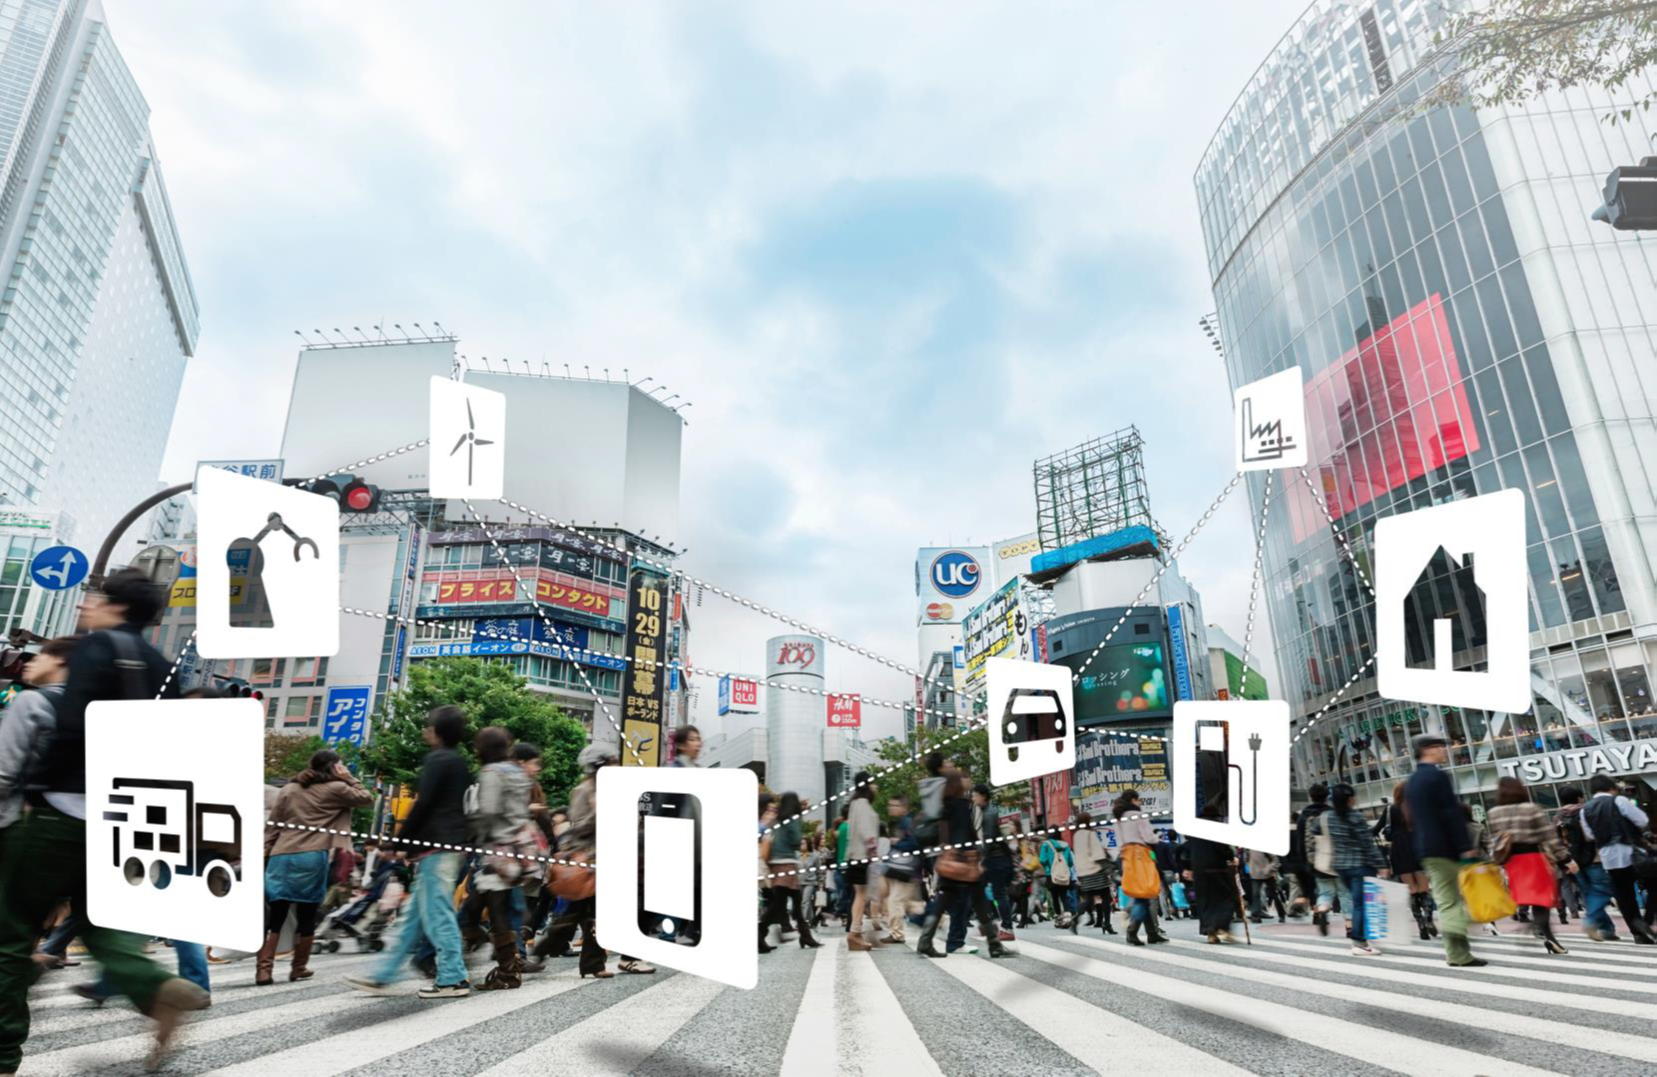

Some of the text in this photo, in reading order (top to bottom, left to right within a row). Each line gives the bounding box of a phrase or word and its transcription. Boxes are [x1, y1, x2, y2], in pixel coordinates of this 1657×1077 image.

[211, 464, 277, 479] 谷駅前
[936, 562, 977, 585] UC
[441, 581, 514, 598] プライス
[537, 582, 607, 609] コンタクト
[635, 612, 660, 637] 29
[776, 647, 815, 670] 109
[736, 683, 754, 692] UNI
[627, 695, 659, 710] 日本 VS
[735, 693, 755, 703] QLO
[1502, 743, 1657, 781] TSUTAYA
